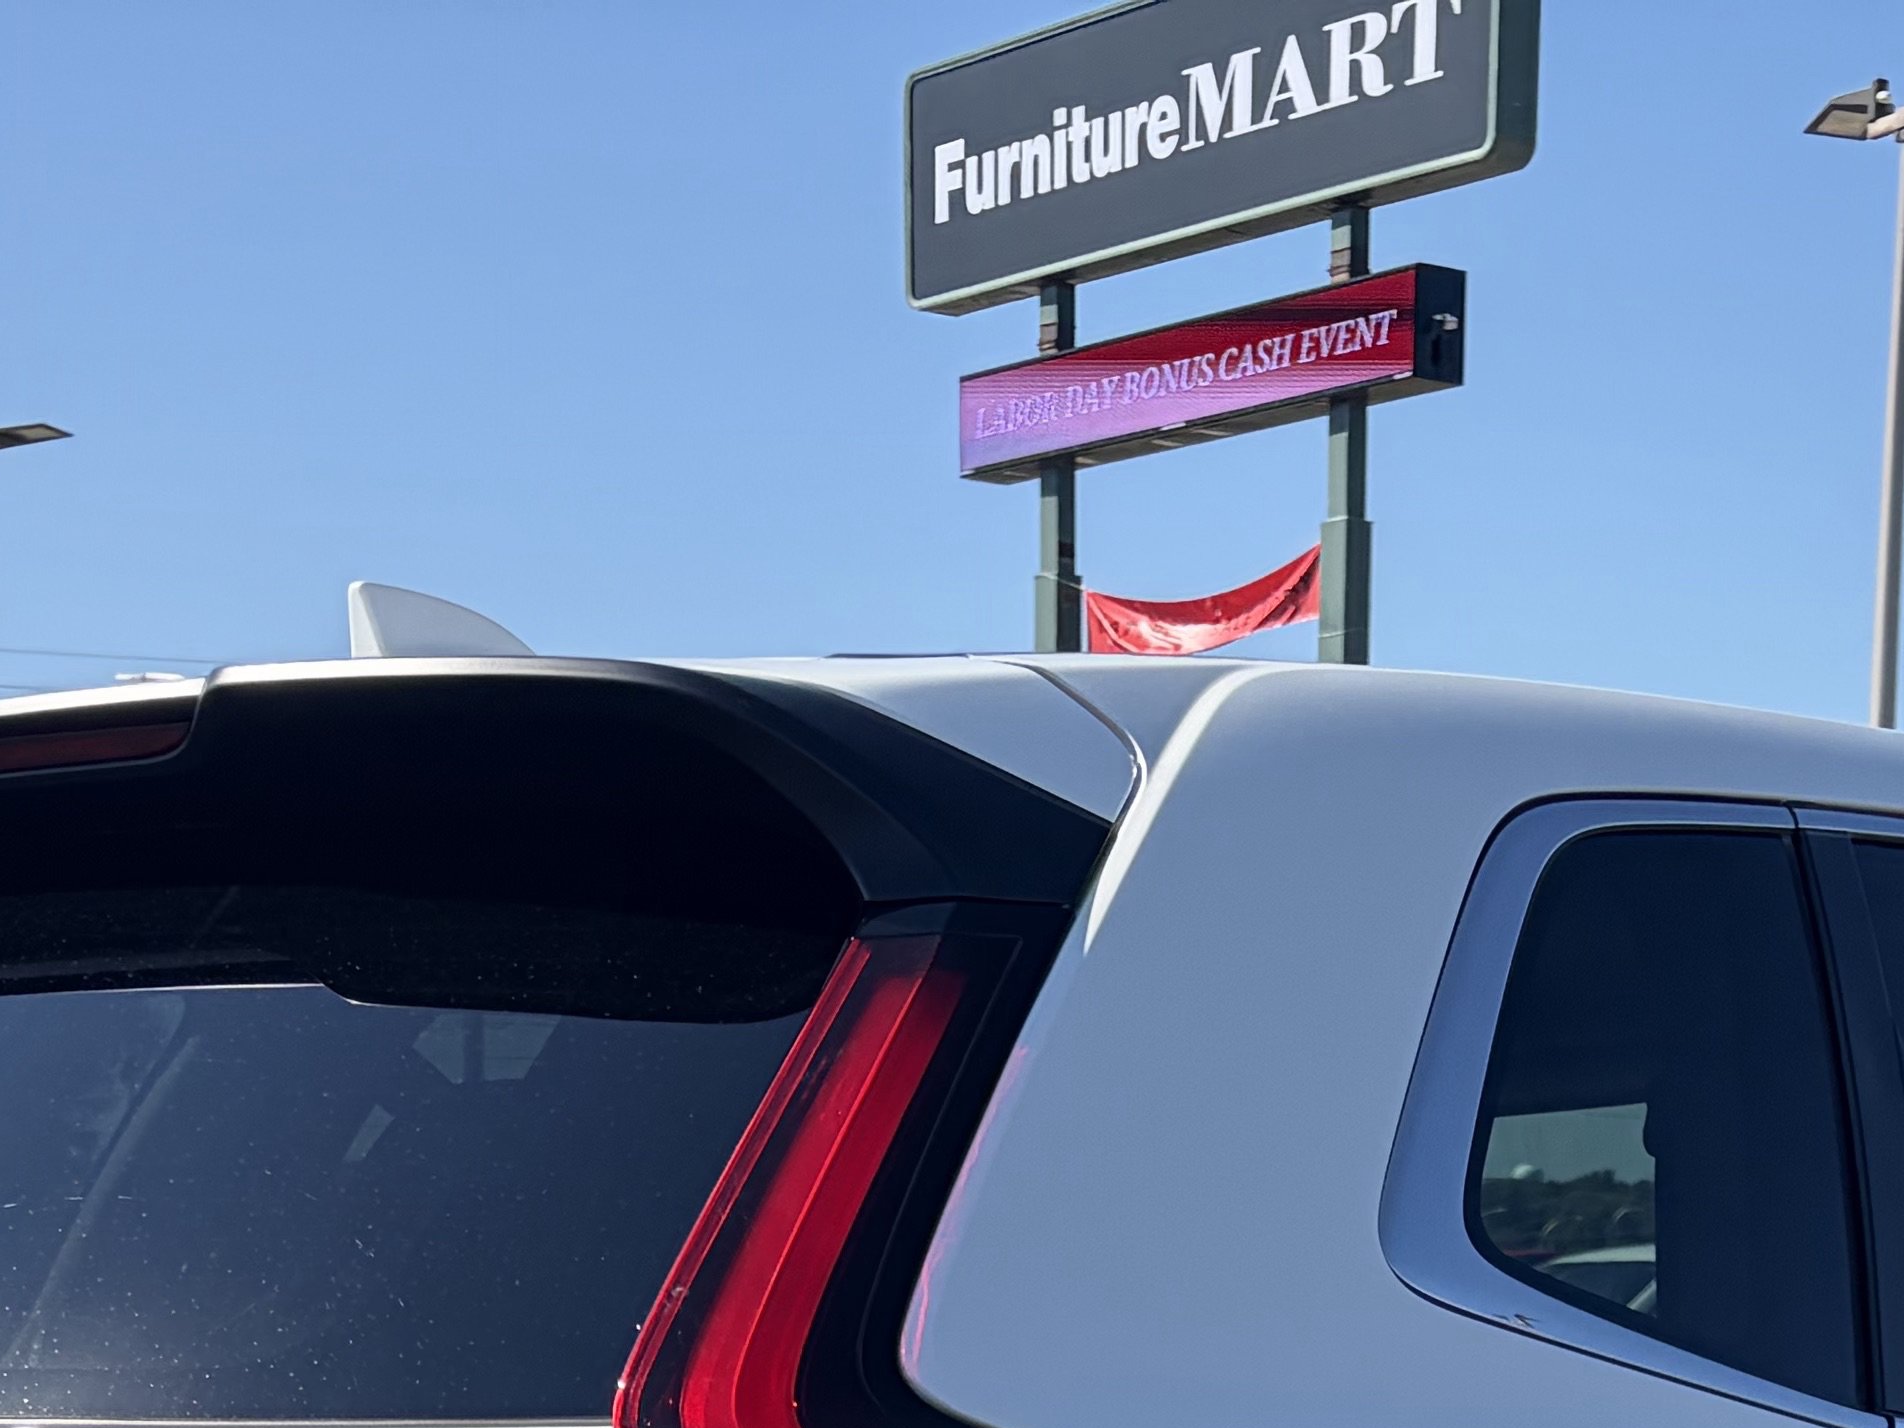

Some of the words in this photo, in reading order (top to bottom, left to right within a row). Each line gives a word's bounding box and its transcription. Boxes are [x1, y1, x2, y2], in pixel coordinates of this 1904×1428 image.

[933, 0, 1465, 225] FurnitureMART
[974, 391, 1058, 439] LABOR
[1063, 375, 1121, 419] DAY
[1123, 353, 1215, 402] BONUS
[1218, 334, 1295, 380] CASH
[1297, 309, 1398, 364] EVENT
